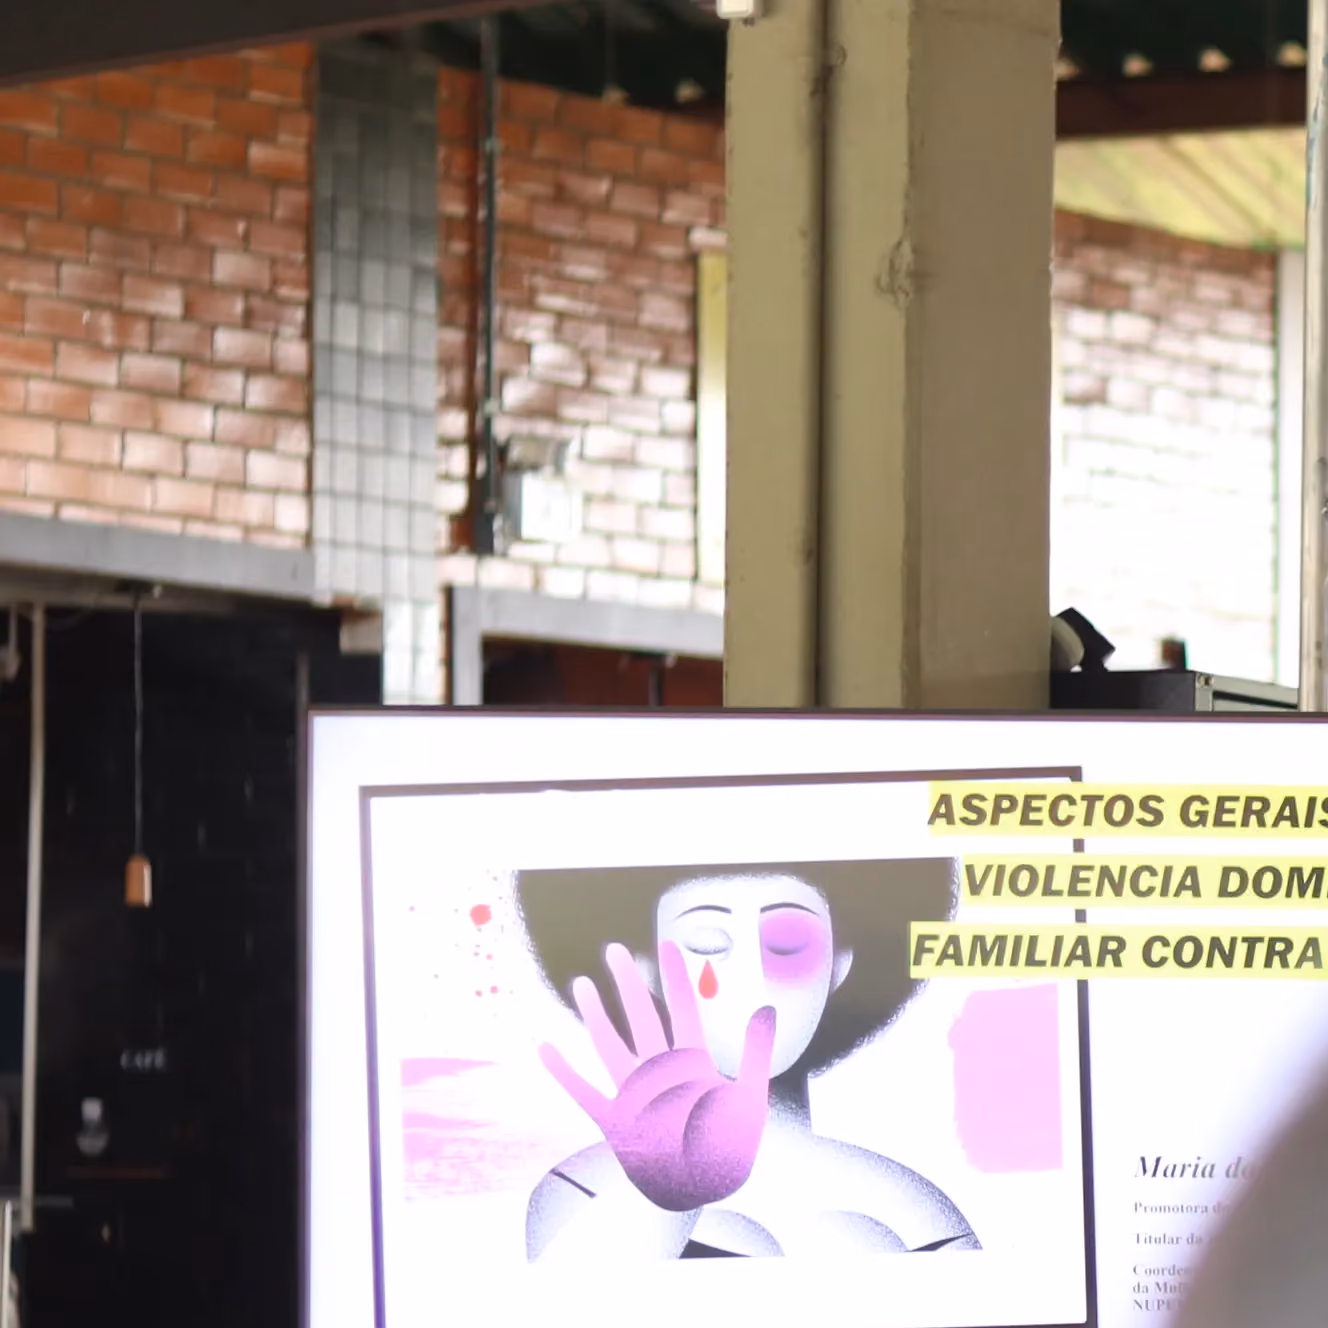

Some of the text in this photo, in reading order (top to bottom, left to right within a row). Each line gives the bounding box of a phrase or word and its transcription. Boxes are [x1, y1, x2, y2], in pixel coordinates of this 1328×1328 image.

[928, 793, 1166, 827] ASPECTOS
[912, 933, 1128, 968] FAMILIAR
[1141, 935, 1324, 969] CONTRA
[1134, 1156, 1217, 1179] Maria
[1134, 1202, 1209, 1214] Promotora
[1135, 1233, 1182, 1245] Titular
[1132, 1283, 1149, 1294] da
